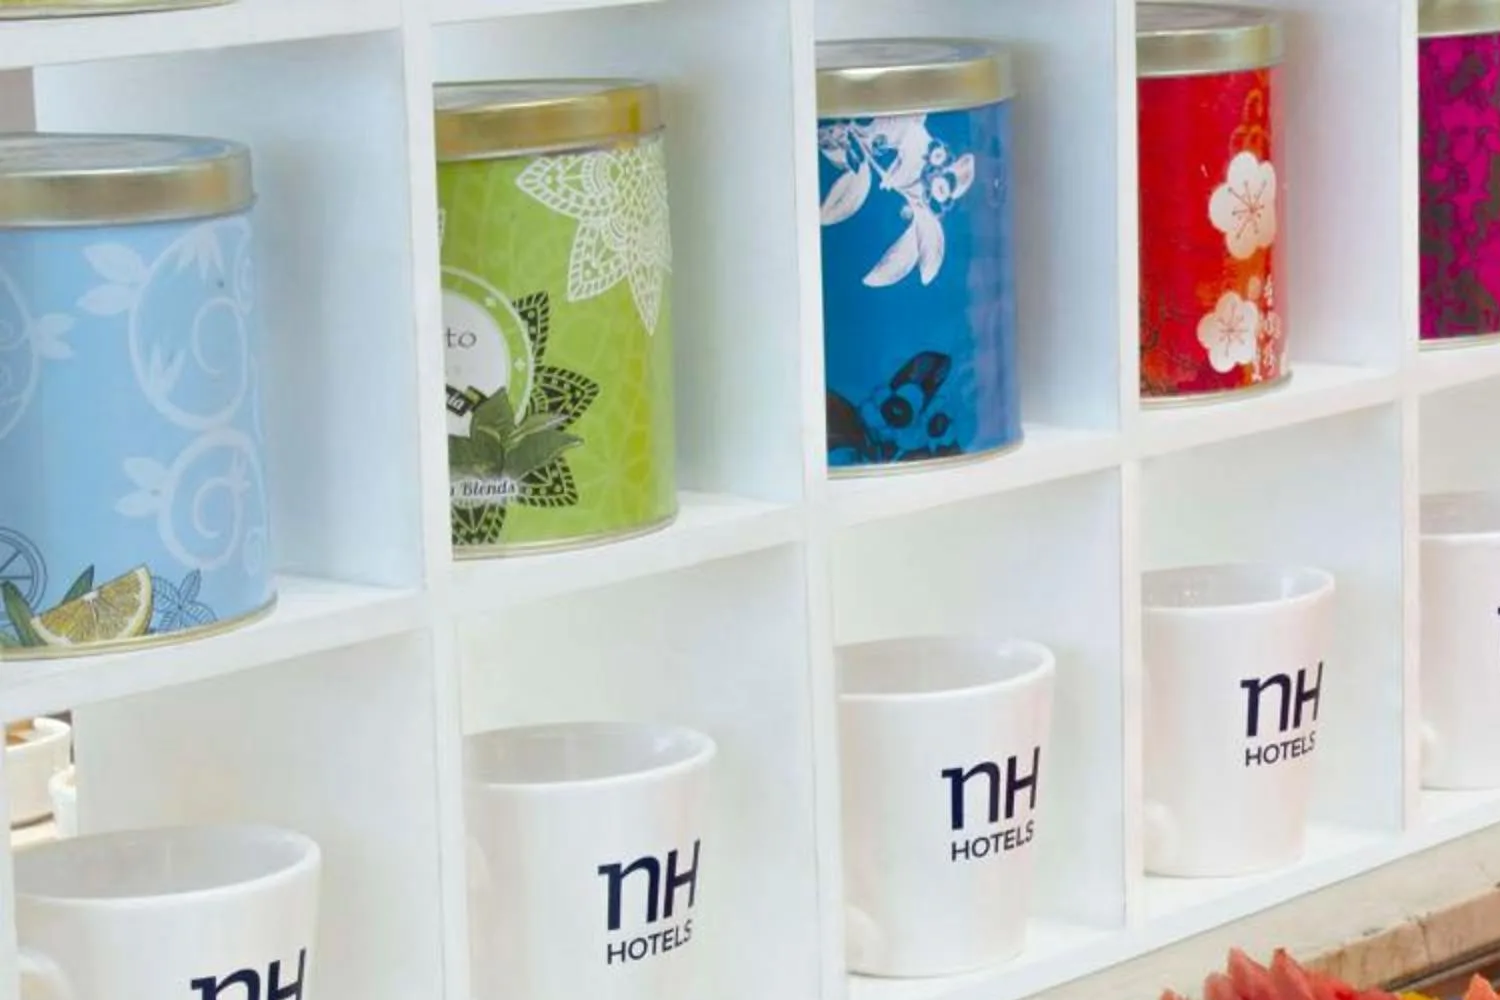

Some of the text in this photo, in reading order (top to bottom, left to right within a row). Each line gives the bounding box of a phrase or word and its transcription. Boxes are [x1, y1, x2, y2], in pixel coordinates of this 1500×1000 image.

[462, 480, 516, 496] Blends
[1245, 729, 1318, 767] HOTELS
[951, 819, 1035, 862] HOTELS
[607, 919, 693, 965] HOTELS
